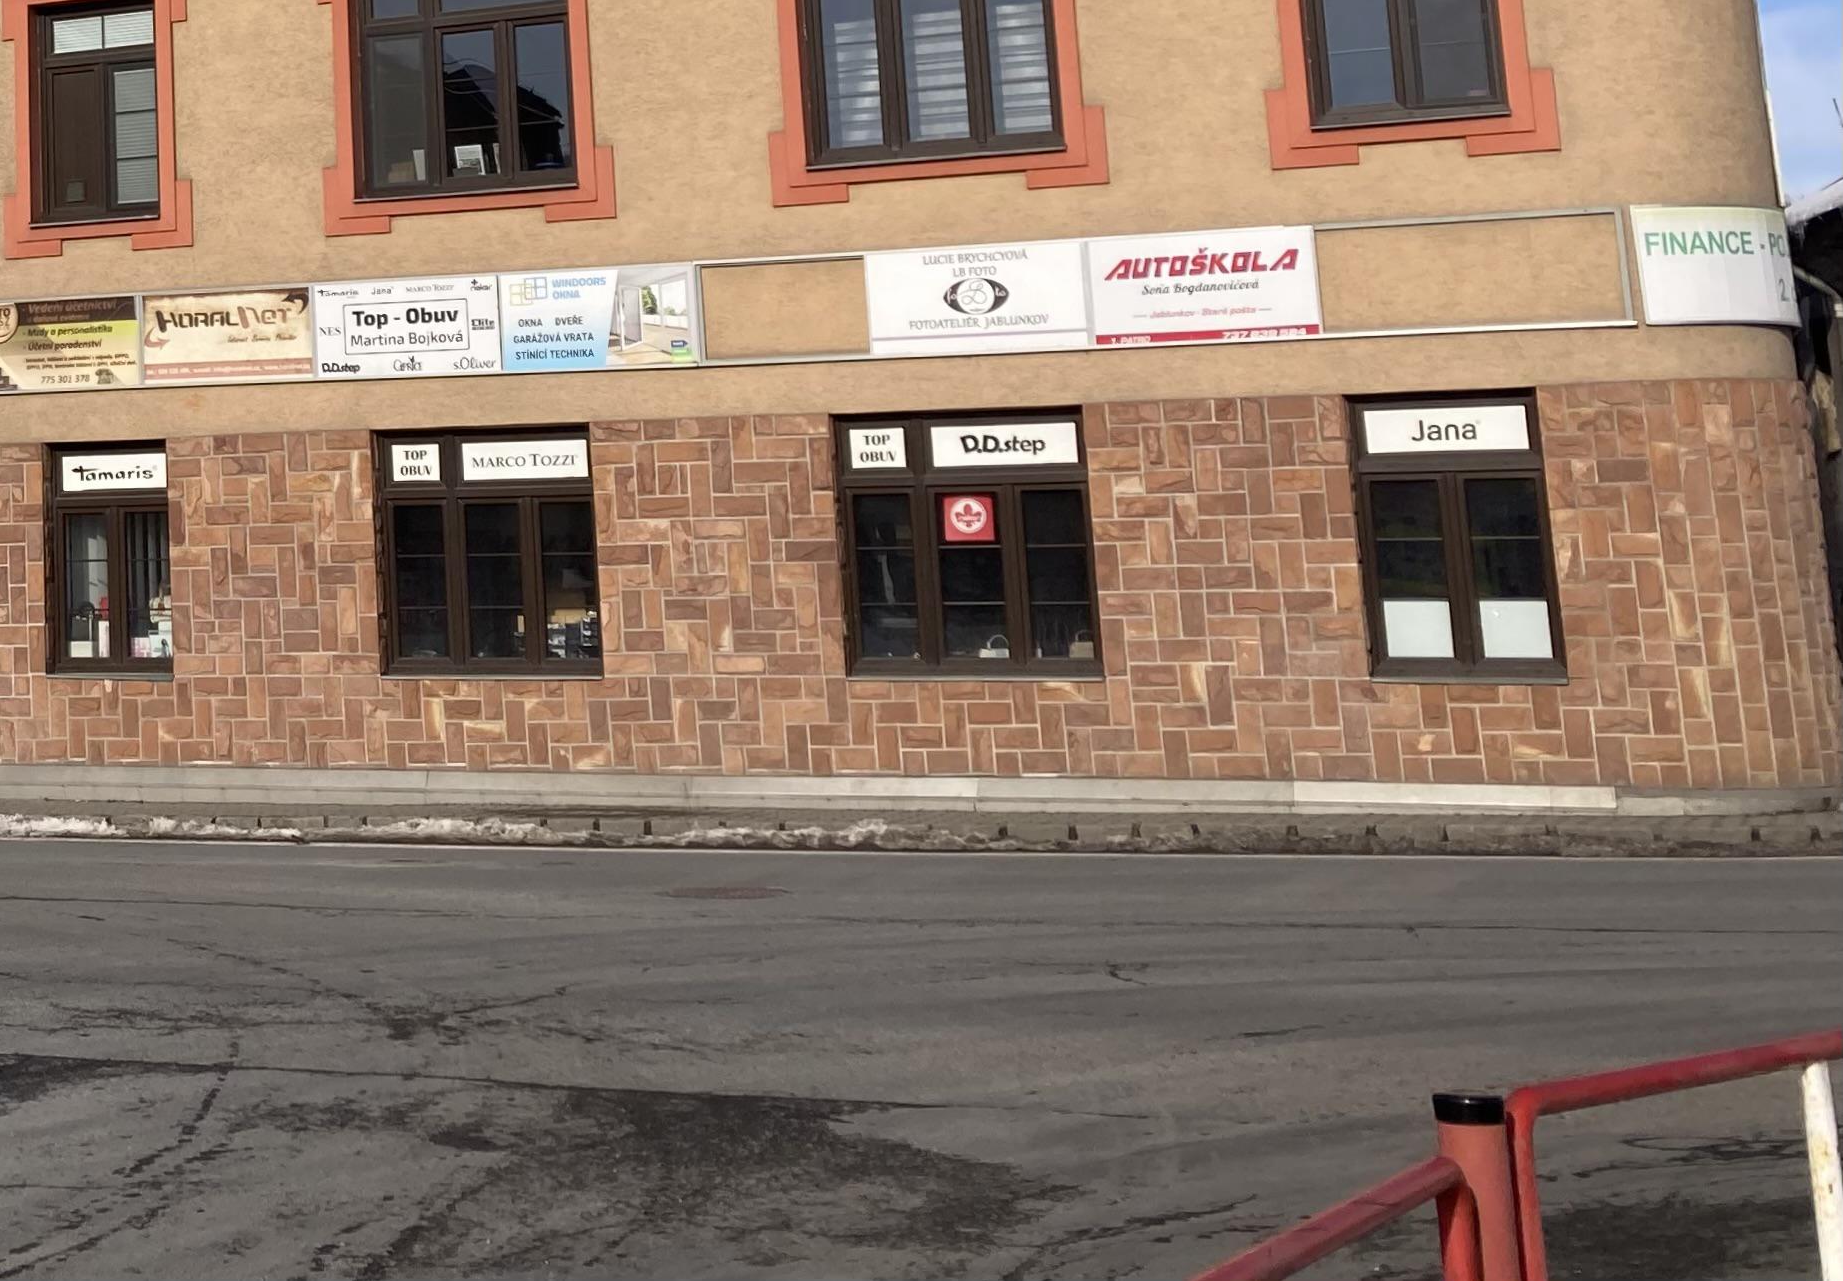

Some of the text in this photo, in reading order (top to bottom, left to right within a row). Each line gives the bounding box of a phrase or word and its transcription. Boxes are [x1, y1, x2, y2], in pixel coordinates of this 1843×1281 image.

[1644, 231, 1754, 256] FINANCE
[1769, 232, 1790, 257] PO
[922, 254, 955, 265] LUCIE
[1104, 247, 1299, 281] AUTOŠKOLA
[952, 266, 997, 278] LB FOTO
[552, 277, 606, 288] WINDOORS
[1142, 279, 1260, 296] Soňa Bogdanovičová
[552, 290, 580, 300] OKNA
[65, 299, 118, 312] účetnictví
[352, 309, 388, 330] Top
[406, 307, 458, 325] Obuv
[518, 315, 584, 328] OKNA DVEŘE
[909, 314, 1050, 331] FOTOATELIÉR JABLUNKOV
[28, 328, 48, 338] Mzdy
[58, 326, 113, 337] personalistika
[351, 330, 464, 347] Martina Bojková
[513, 332, 594, 344] GARÁŽOVÁ VRATA
[28, 339, 102, 352] Účetní poradenství
[515, 348, 595, 361] STÍNÍCÍ TECHNIKA
[41, 376, 55, 384] 775
[1411, 419, 1478, 442] Jana
[862, 435, 891, 446] TOP
[961, 434, 1046, 455] D.D.step
[403, 450, 428, 461] TOP
[472, 454, 575, 468] MARCO TOZZI
[860, 451, 897, 463] OBUV
[400, 465, 432, 476] OBUV
